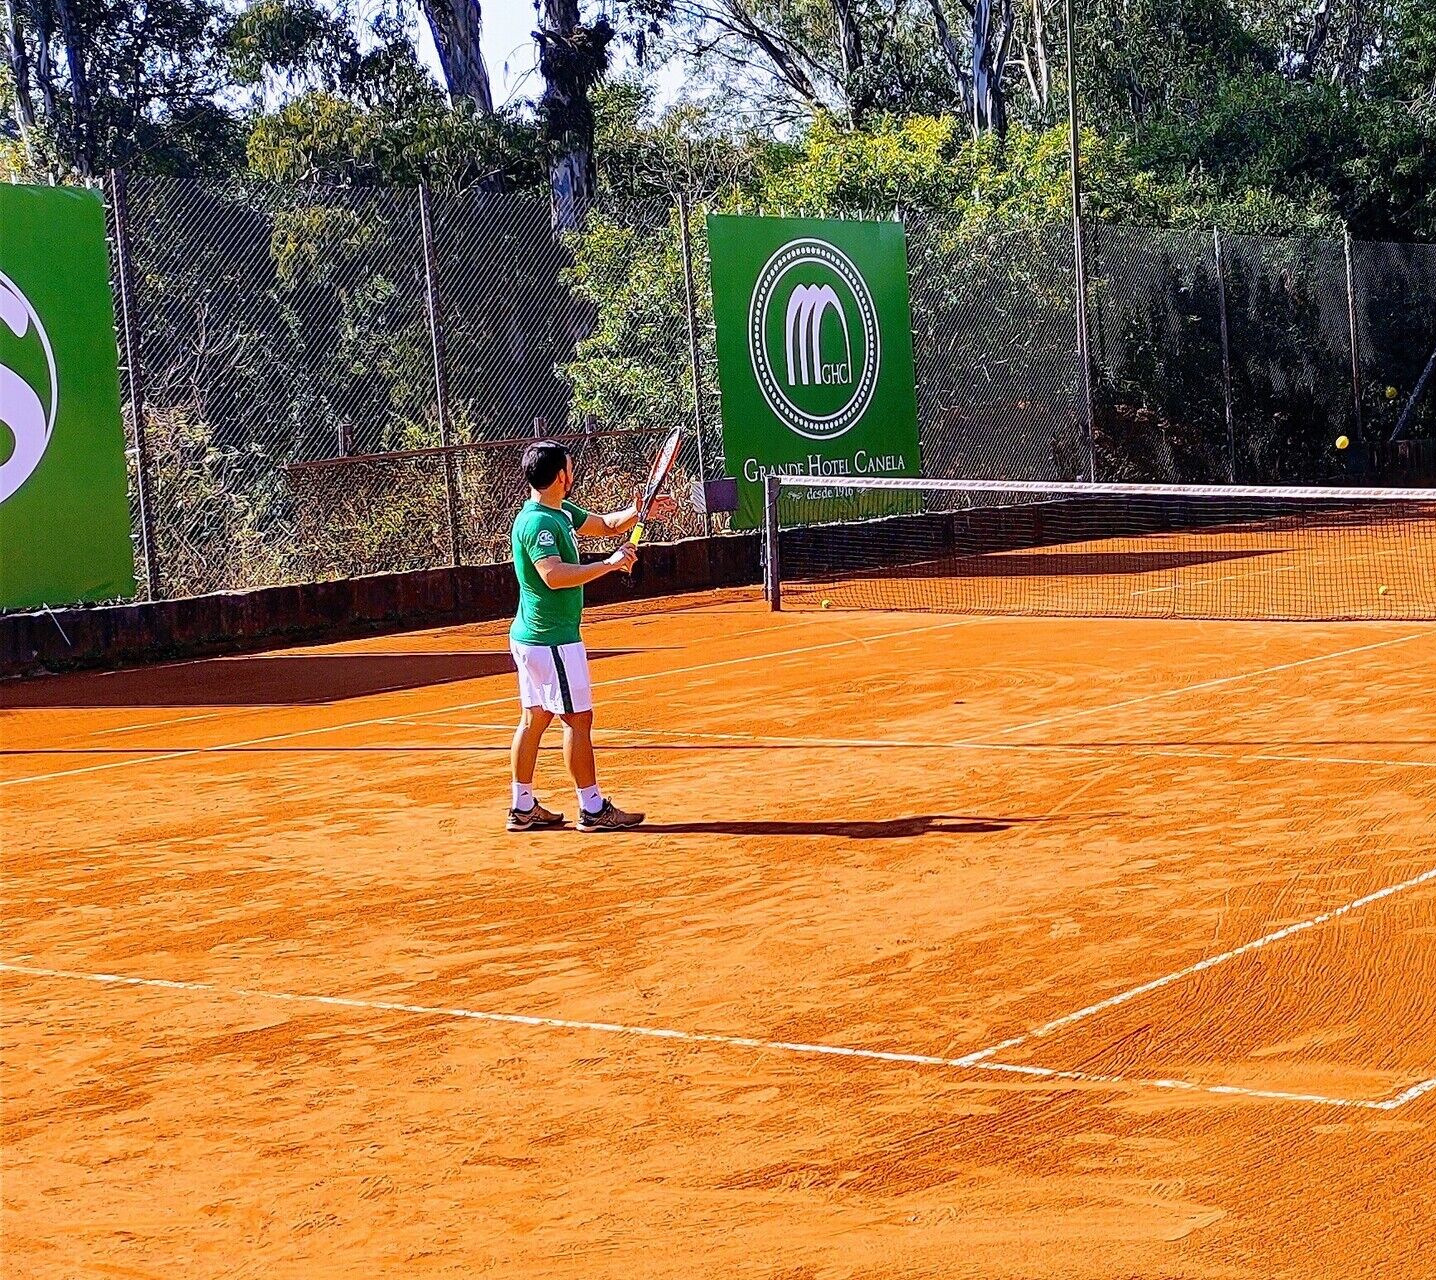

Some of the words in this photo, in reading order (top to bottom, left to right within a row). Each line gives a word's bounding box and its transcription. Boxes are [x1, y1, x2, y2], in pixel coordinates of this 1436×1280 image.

[821, 362, 848, 385] GHC
[743, 458, 804, 483] GRANDE
[807, 454, 851, 477] HOTEL
[854, 450, 905, 473] CANELA
[806, 486, 833, 500] desde
